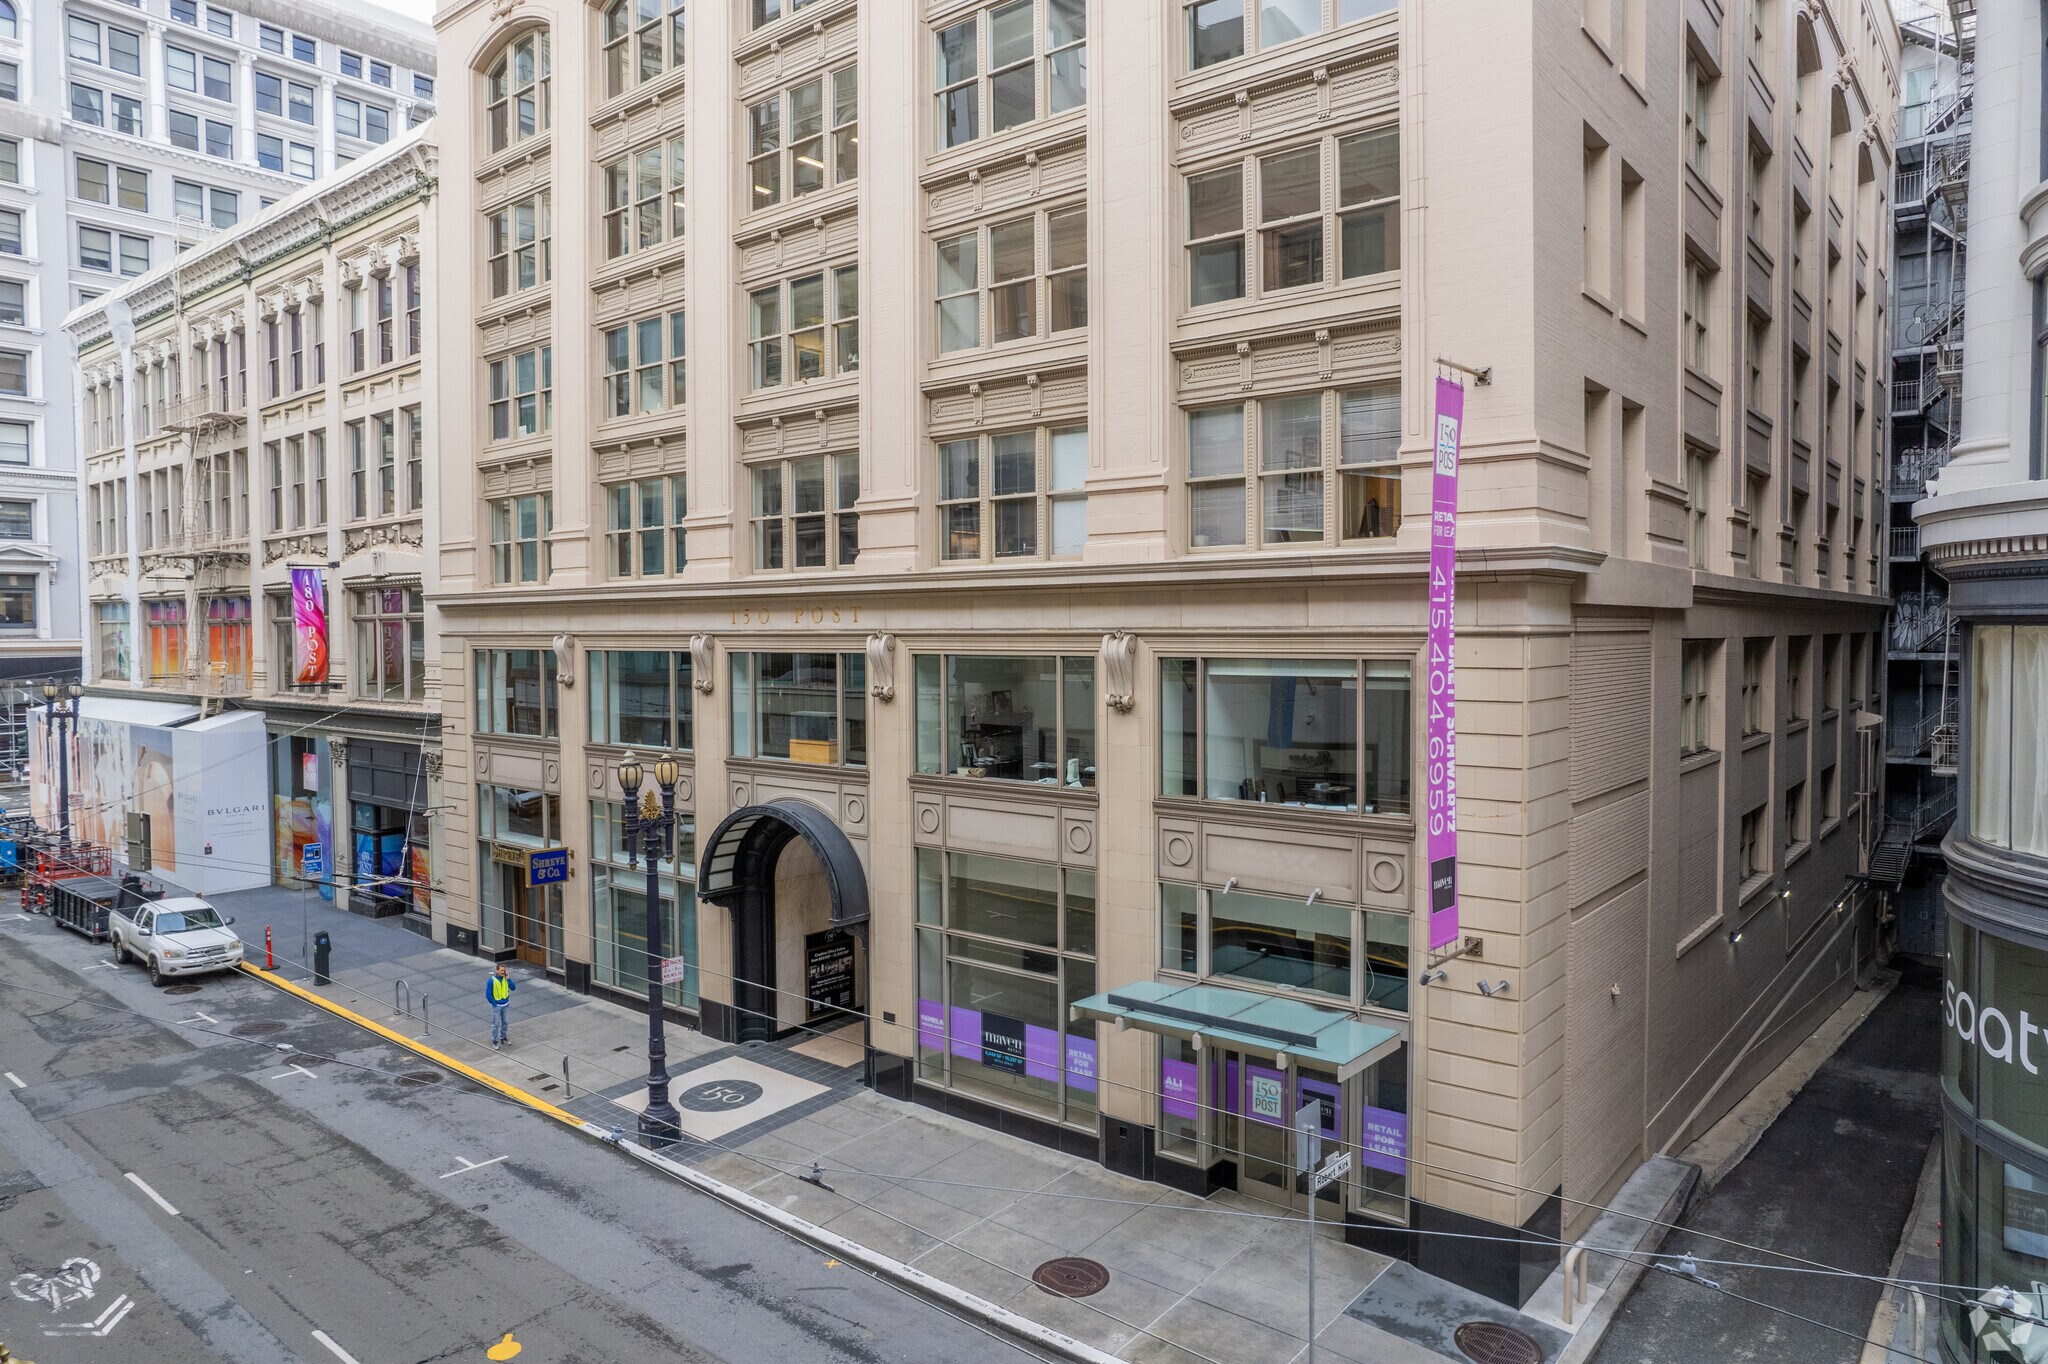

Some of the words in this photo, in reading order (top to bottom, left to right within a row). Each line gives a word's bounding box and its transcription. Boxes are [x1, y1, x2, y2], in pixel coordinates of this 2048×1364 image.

[1440, 424, 1456, 449] 150
[1434, 511, 1455, 523] RETA
[1434, 525, 1442, 536] FOR
[1444, 527, 1455, 538] LEA
[304, 574, 314, 612] 180
[731, 607, 770, 624] 150
[794, 606, 861, 624] POST
[306, 626, 318, 676] POST
[1430, 566, 1446, 836] 415.404.6959
[1447, 717, 1455, 833] SCHWARTZ
[208, 804, 264, 815] BVLGARI
[532, 857, 565, 869] SHREVE
[538, 869, 545, 879] &
[985, 1032, 1022, 1050] maven
[1069, 1049, 1094, 1061] RETAIL
[1074, 1058, 1089, 1068] FOR
[1069, 1066, 1093, 1076] LEASE
[1165, 1076, 1182, 1088] ALI
[1256, 1080, 1278, 1097] 150
[699, 1086, 745, 1104] 150
[1255, 1100, 1278, 1114] POST
[1368, 1123, 1402, 1137] RETAIL
[1374, 1134, 1395, 1146] FOR
[1369, 1143, 1400, 1156] LEASE
[1316, 1168, 1336, 1186] Robert
[1338, 1160, 1349, 1174] Kirk
